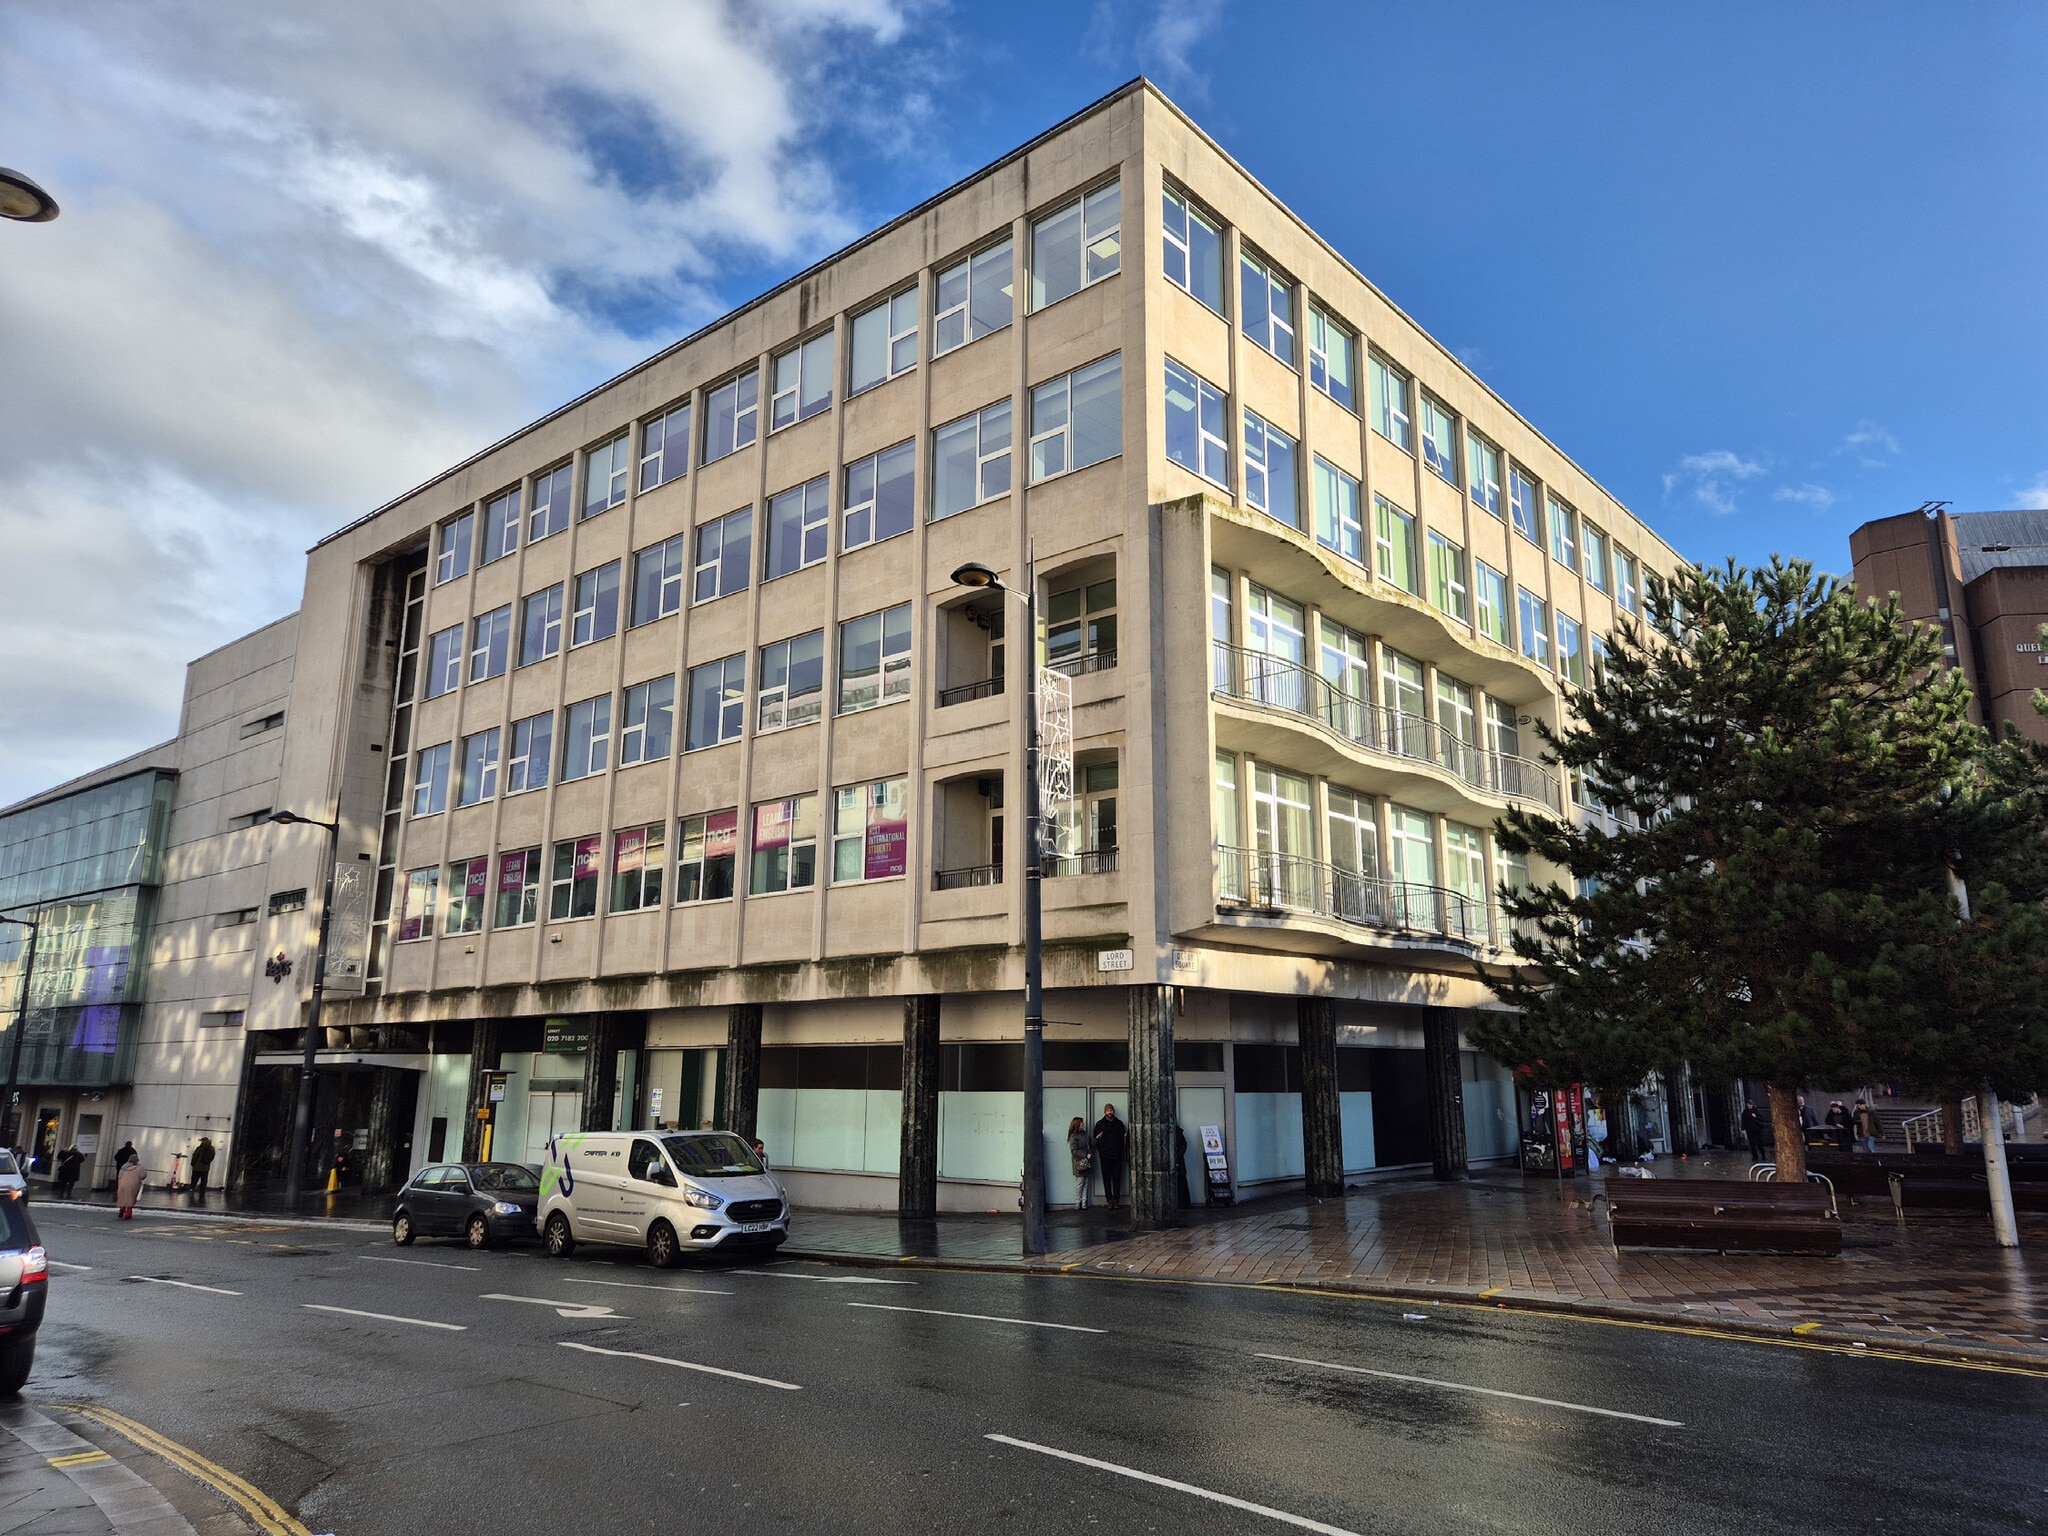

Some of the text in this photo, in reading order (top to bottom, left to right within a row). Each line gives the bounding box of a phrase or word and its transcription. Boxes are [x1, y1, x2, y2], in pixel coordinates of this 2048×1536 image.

[707, 828, 731, 844] ncg
[868, 832, 906, 845] INTERNATIONAL
[576, 852, 596, 867] ncg
[468, 872, 487, 886] ncg
[1106, 951, 1125, 961] LORD
[1103, 960, 1128, 969] STREET
[1175, 960, 1195, 970] SQUARE
